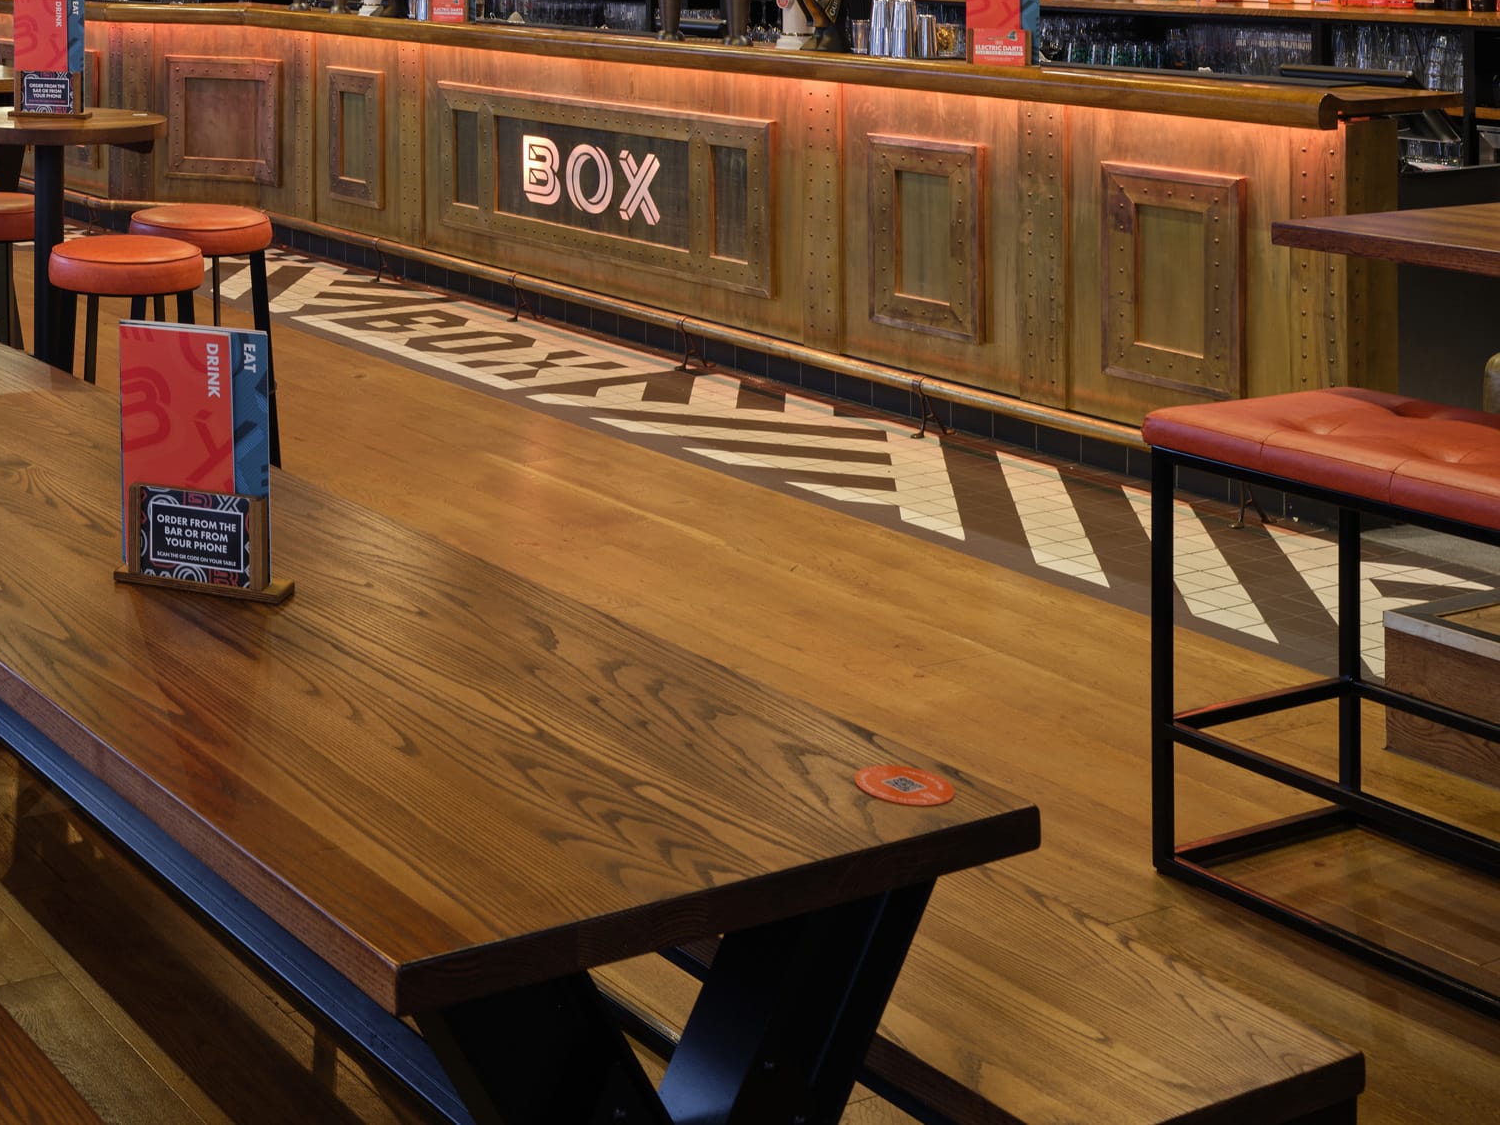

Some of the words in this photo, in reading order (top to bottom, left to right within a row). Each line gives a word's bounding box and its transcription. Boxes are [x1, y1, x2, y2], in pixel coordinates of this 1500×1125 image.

[55, 0, 63, 28] DRINK
[975, 44, 1002, 52] ELECTRIC
[522, 134, 660, 226] BOX
[243, 343, 256, 373] EAT
[205, 342, 221, 399] DRINK
[156, 514, 188, 526] ORDER
[190, 518, 217, 530] FROM
[219, 522, 236, 533] THE
[164, 526, 182, 537] BAR
[185, 529, 198, 538] OR
[200, 531, 228, 543] FROM
[165, 537, 192, 549] YOUR
[194, 541, 227, 553] PHONE
[223, 559, 236, 567] TABLE
